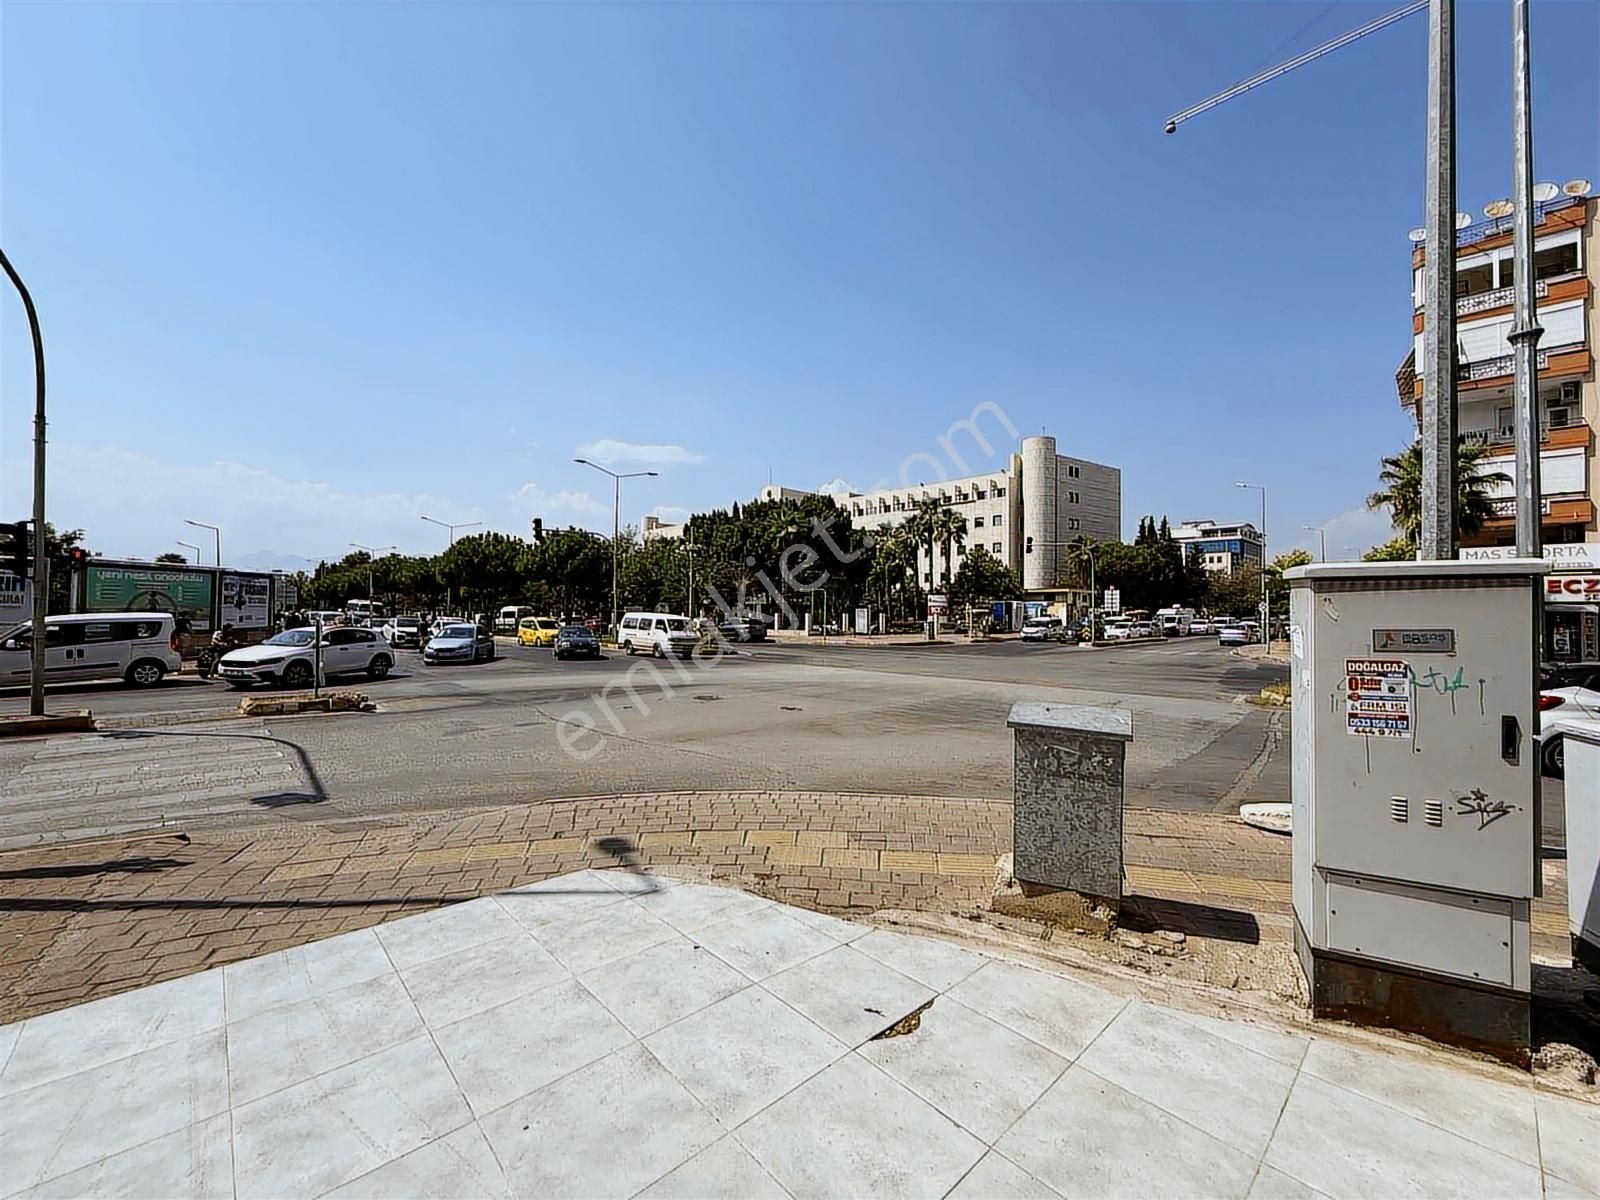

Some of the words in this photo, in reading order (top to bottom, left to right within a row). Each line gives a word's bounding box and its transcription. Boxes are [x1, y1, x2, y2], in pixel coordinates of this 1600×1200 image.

[1465, 549, 1502, 560] MAS
[1507, 546, 1588, 560] SORTA
[1347, 661, 1406, 673] DOĞALGAZ
